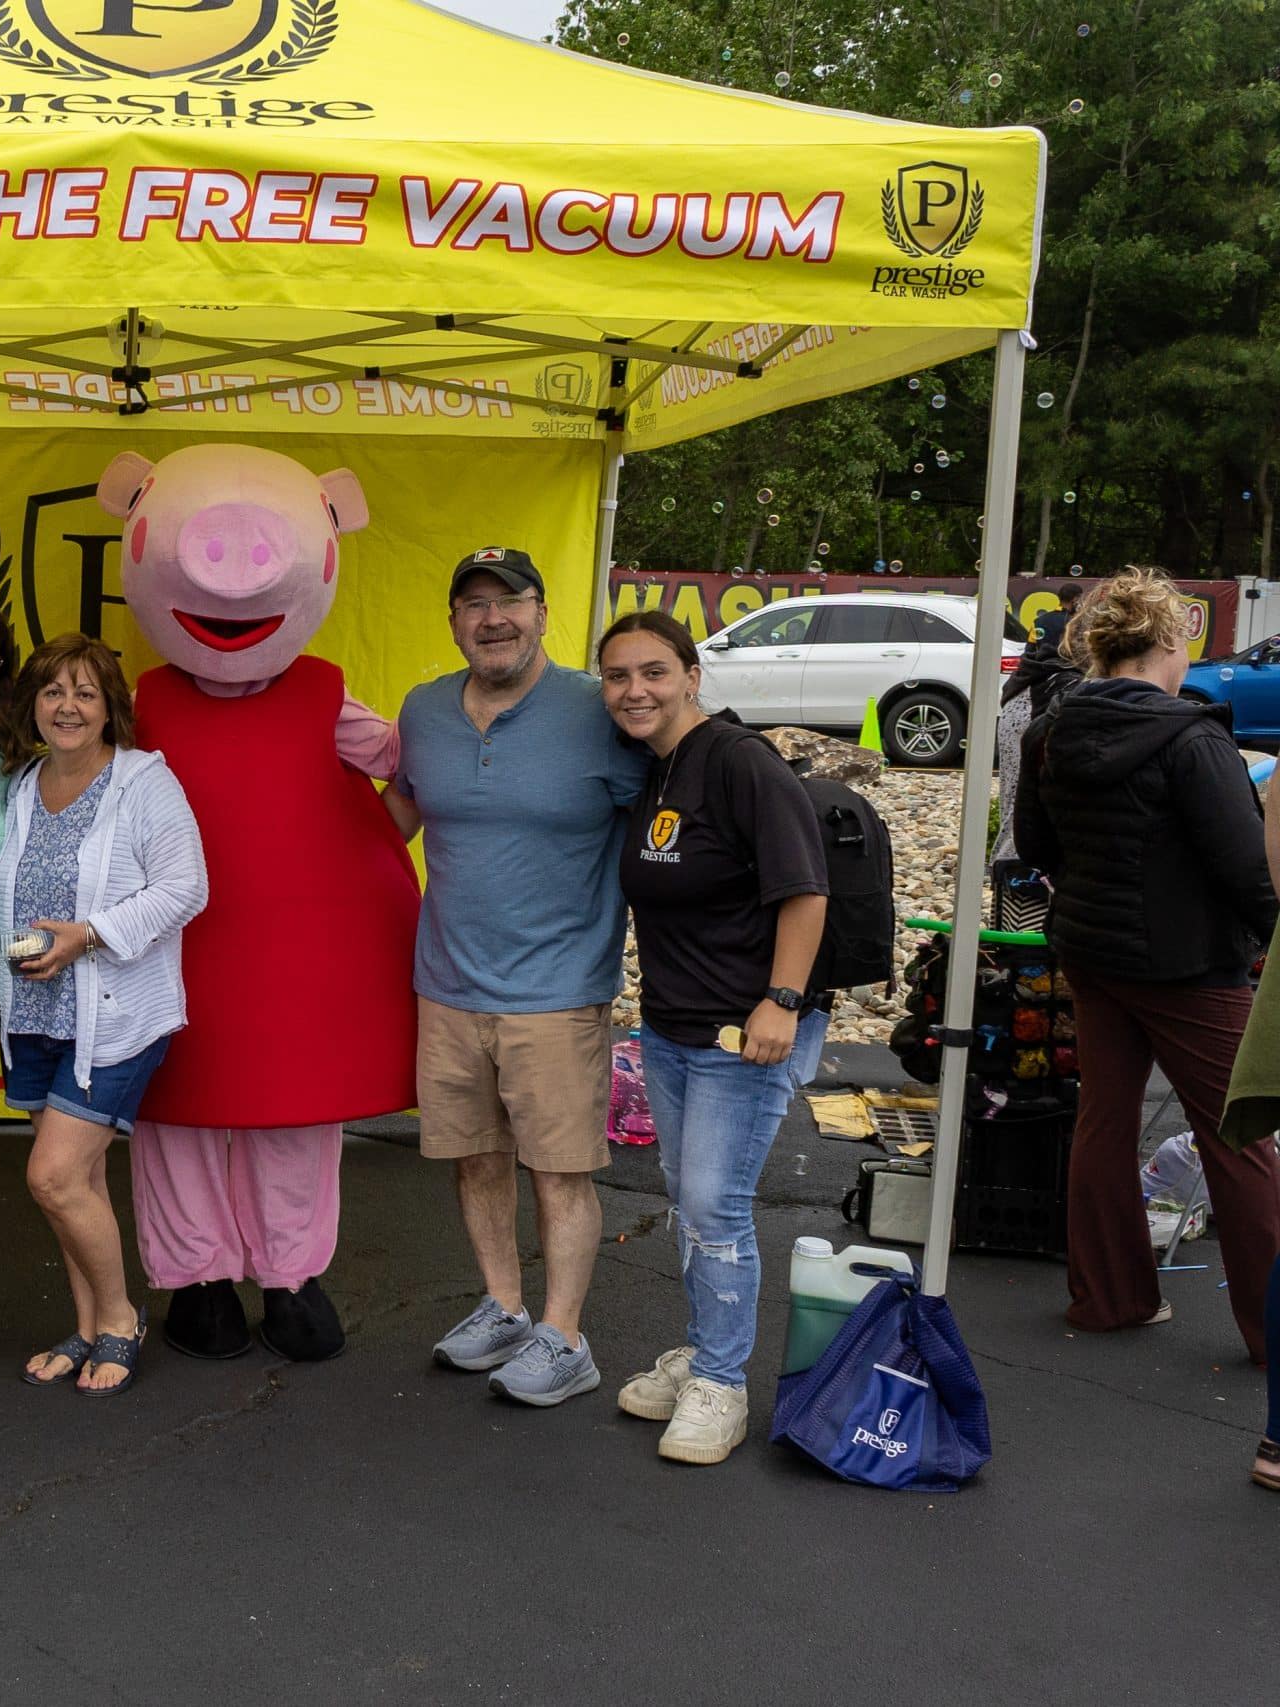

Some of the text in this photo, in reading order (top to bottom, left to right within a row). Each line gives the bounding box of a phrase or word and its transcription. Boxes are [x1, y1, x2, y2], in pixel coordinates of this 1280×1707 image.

[95, 114, 236, 129] WASH
[911, 180, 957, 227] P
[119, 166, 379, 245] FREE
[399, 175, 845, 264] VACUUM
[869, 261, 985, 296] prestige
[882, 285, 948, 299] CAR WASH
[656, 817, 674, 837] P
[640, 849, 681, 863] PRESTIGE
